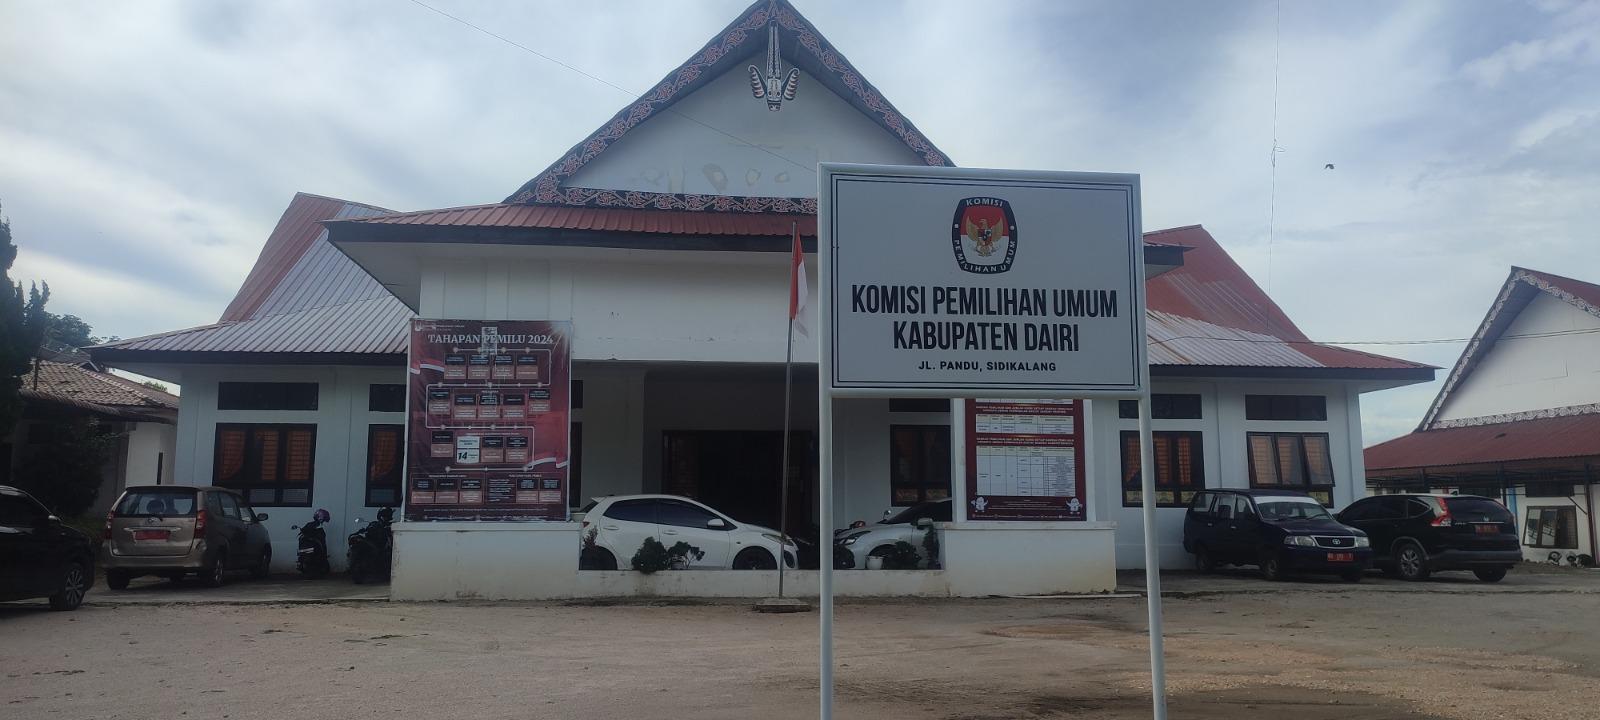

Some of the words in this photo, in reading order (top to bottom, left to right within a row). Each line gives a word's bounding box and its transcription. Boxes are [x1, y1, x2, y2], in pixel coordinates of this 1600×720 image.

[965, 198, 1003, 207] KOMISI
[954, 239, 997, 272] PEMILIHAN
[1000, 240, 1016, 271] UMUM
[851, 284, 926, 314] KOMISI
[933, 286, 1047, 316] PEMILIHAN
[1053, 289, 1118, 318] UMUM
[428, 334, 481, 344] TAHAPAN
[483, 334, 525, 344] PEMILU
[528, 334, 553, 344] 2024
[893, 321, 1017, 350] KABUPATEN
[1024, 323, 1079, 351] DAIRI
[918, 360, 935, 370] JL.
[940, 361, 982, 372] PANDU,
[986, 361, 1056, 372] SIDIKALANG
[458, 451, 468, 460] 14
